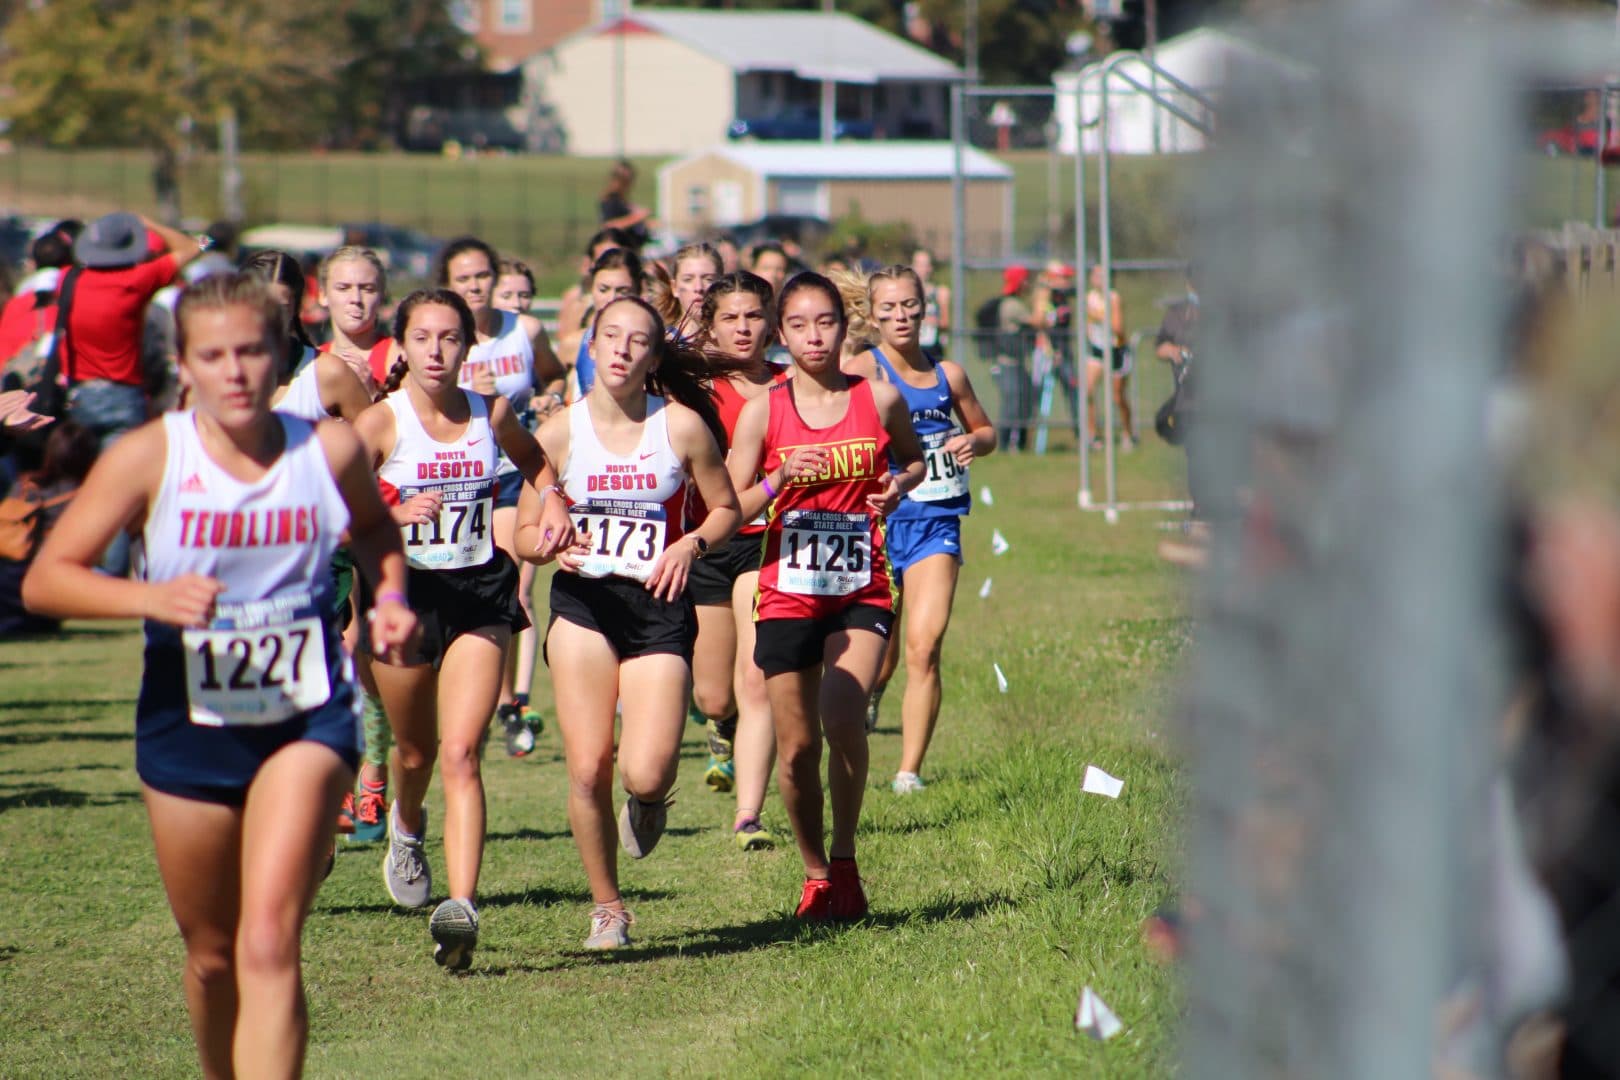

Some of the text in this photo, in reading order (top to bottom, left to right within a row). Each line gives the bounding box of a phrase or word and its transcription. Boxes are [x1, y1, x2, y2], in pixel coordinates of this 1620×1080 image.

[417, 460, 484, 480] DESOTO
[435, 451, 466, 460] NORTH
[605, 465, 637, 473] NORTH
[587, 473, 657, 492] DESOTO
[179, 505, 319, 548] TEURLINGS
[408, 503, 486, 546] 1174
[786, 532, 865, 573] 1125
[199, 629, 310, 691] 1227
